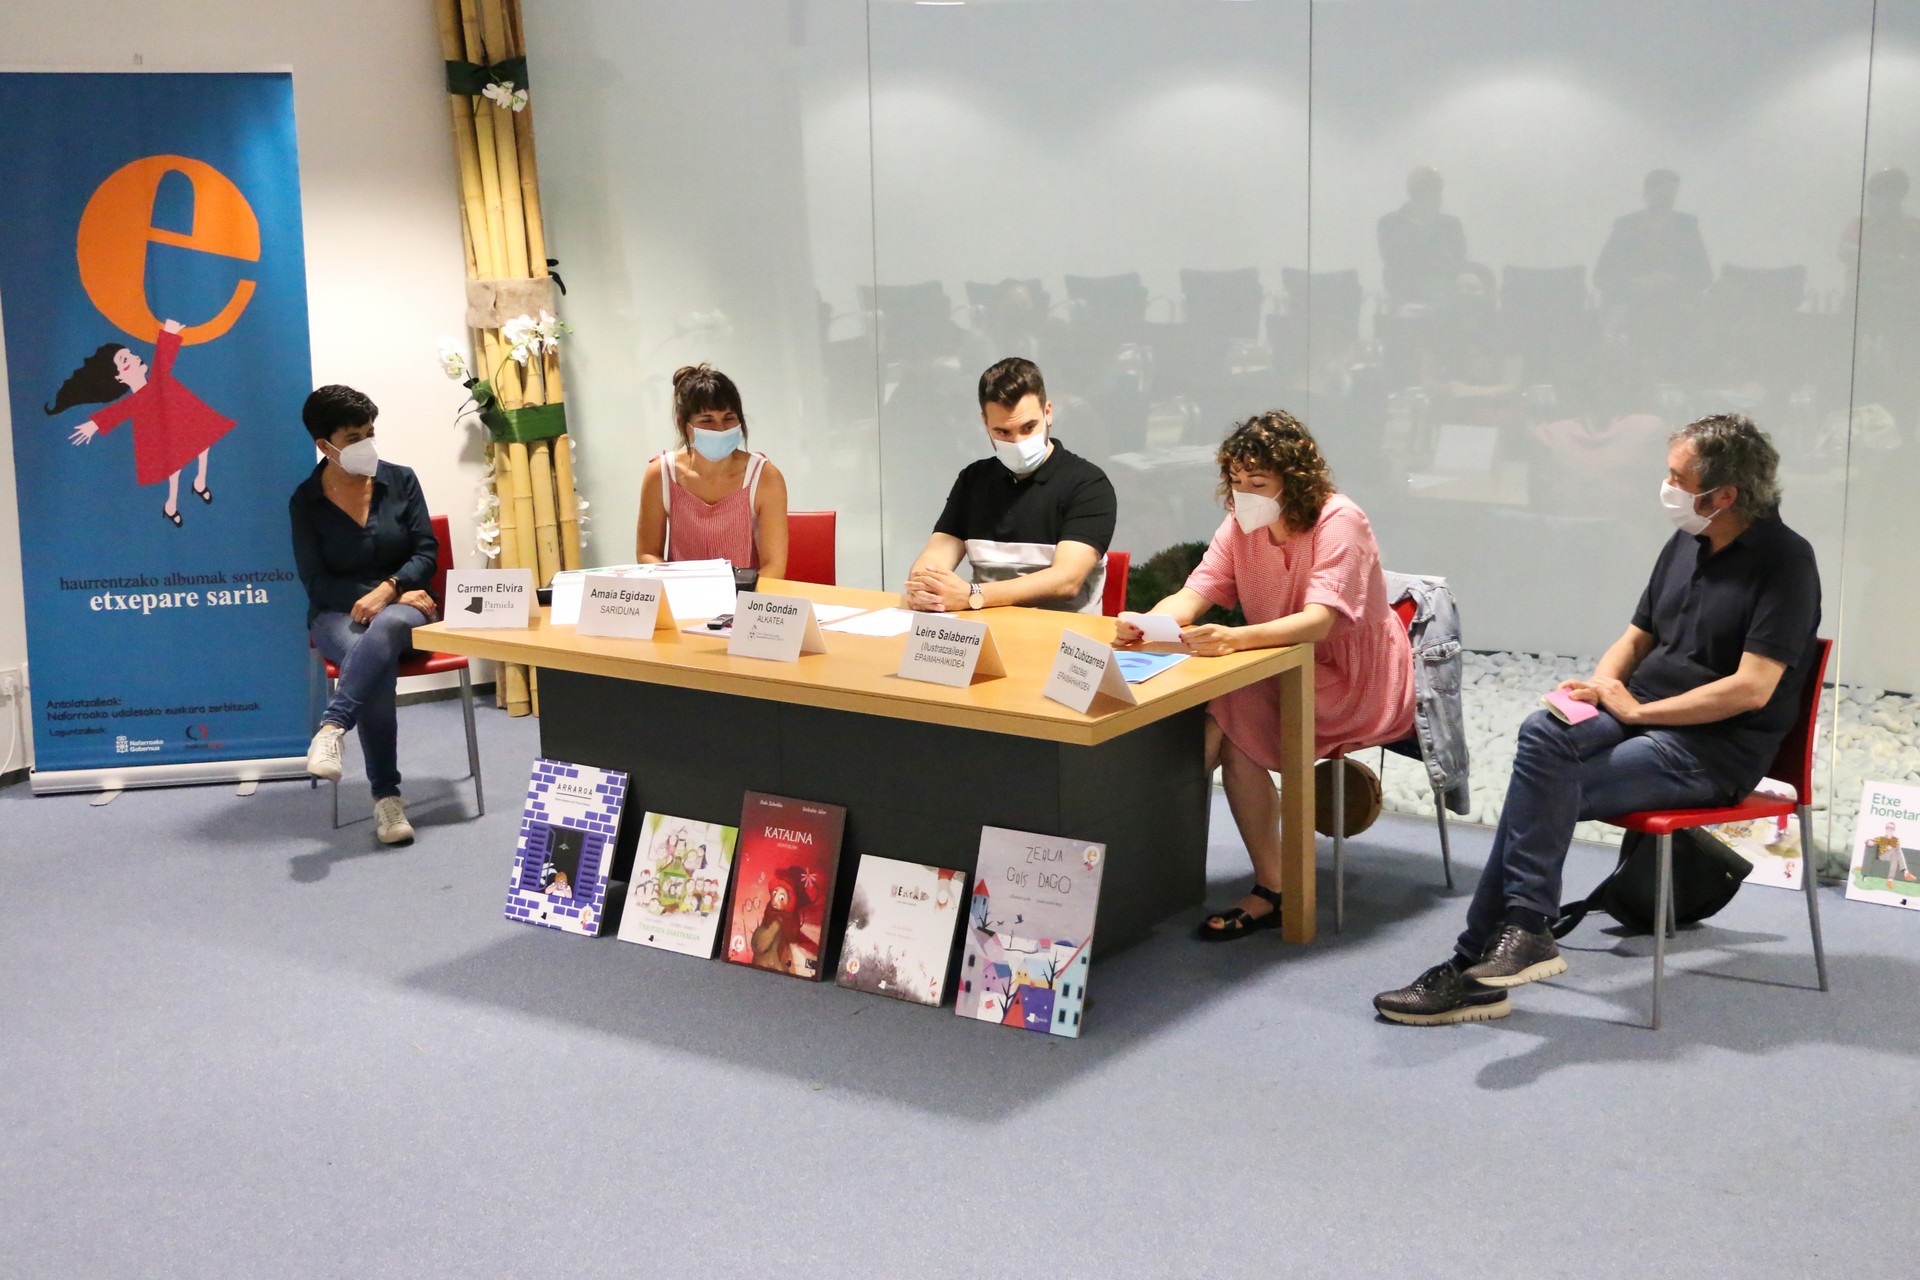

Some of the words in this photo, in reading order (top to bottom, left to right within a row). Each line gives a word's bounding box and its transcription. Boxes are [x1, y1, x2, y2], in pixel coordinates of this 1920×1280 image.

[60, 573, 158, 591] haurrentzako
[164, 571, 227, 587] albumak
[232, 568, 294, 584] sortzeko
[457, 583, 493, 593] Carmen
[496, 583, 523, 593] Elvira
[90, 590, 199, 615] etxepare
[207, 584, 269, 606] saria
[590, 588, 618, 599] Amaia
[620, 590, 656, 602] Egidazu
[600, 605, 640, 616] SARIDUNA
[747, 600, 764, 611] Jon
[765, 602, 798, 616] Gondán
[757, 615, 784, 625] ALKATEA
[916, 626, 936, 639] Leire
[938, 629, 980, 646] Salaberria
[1060, 641, 1075, 656] Patxi
[1074, 648, 1105, 670] Zubizarreta
[47, 711, 108, 721] Nafarroako
[165, 705, 206, 715] euskara
[208, 702, 259, 713] zerbitzuak
[557, 783, 593, 796] ARRAROA
[1872, 793, 1902, 807] Etxe
[764, 826, 813, 845] KATALINA
[1038, 872, 1071, 894] DAGO
